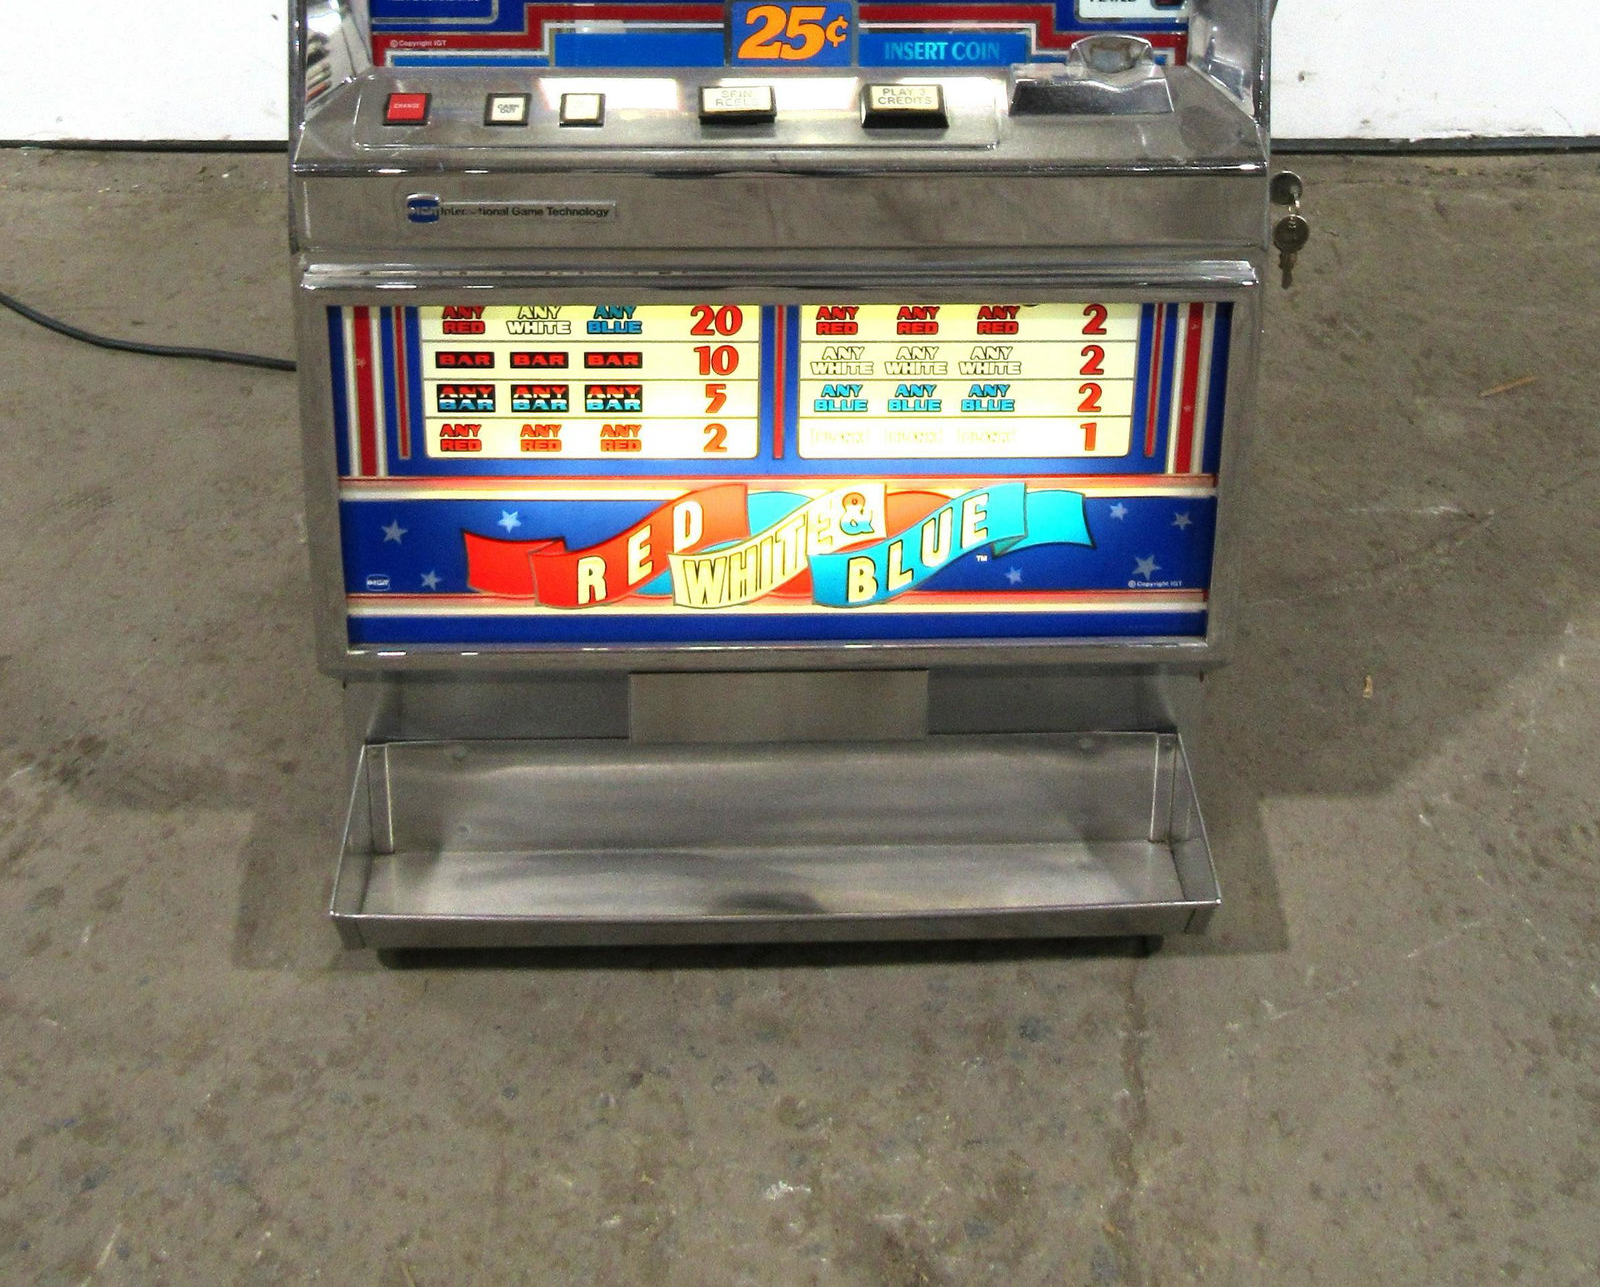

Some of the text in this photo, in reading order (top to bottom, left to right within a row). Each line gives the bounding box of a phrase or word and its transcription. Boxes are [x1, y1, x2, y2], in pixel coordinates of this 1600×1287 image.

[737, 4, 849, 61] 25¢
[885, 42, 1001, 60] INSERT COIN
[878, 96, 932, 105] CREDITS
[883, 88, 913, 96] PLAY
[547, 207, 609, 218] Technology
[441, 305, 637, 319] ANY ANY ANY
[690, 304, 743, 336] 20
[816, 304, 1108, 335] ANY ANY ANY 2
[442, 321, 643, 334] RED WHITE BLUE
[816, 321, 1019, 335] RED RED RED
[693, 345, 739, 376] 10
[810, 361, 1021, 375] WHITE WHITE WHITE
[822, 345, 1105, 375] ANY ANY ANY 2
[439, 383, 727, 413] ANY ANY ANY 5
[439, 399, 641, 411] BAR BAR BAR
[814, 399, 1015, 412] BLUE BLUE BLUE
[821, 383, 1103, 413] ANY ANY ANY 2
[439, 423, 728, 453] ANY ANY ANY 2
[440, 439, 642, 452] RED RED RED
[1080, 422, 1098, 451] 1
[577, 492, 990, 604] RED WHITE & BLUE
